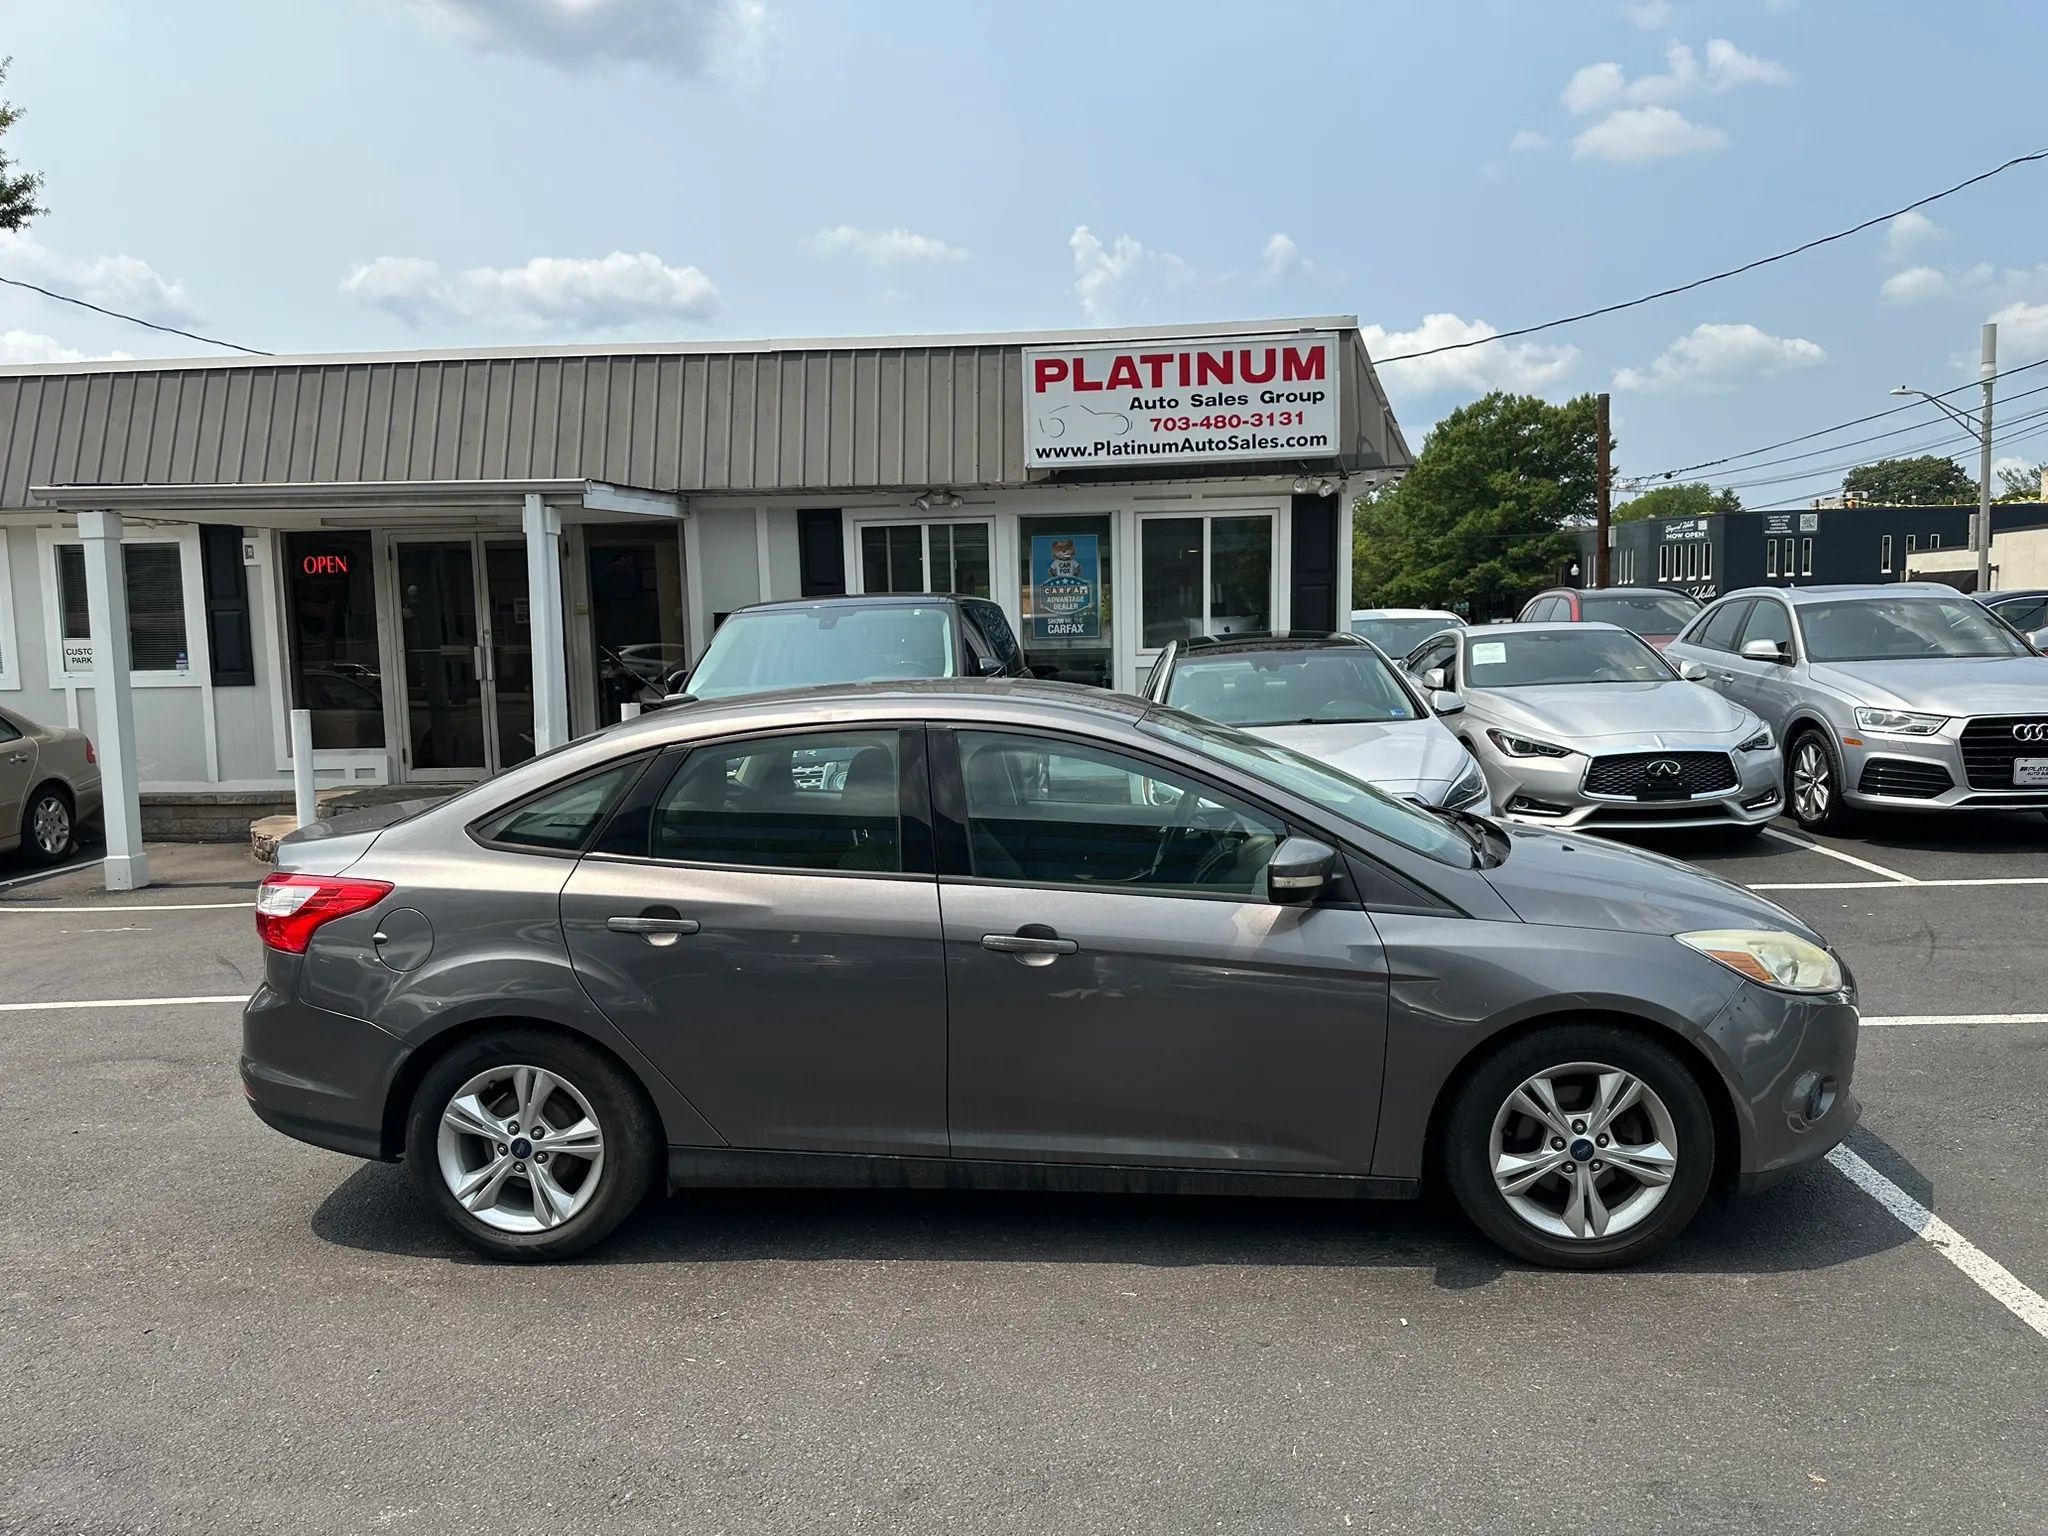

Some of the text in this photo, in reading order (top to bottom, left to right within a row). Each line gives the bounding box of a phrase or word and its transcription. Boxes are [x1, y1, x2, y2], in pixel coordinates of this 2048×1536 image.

[1035, 346, 1326, 393] PLATINUM
[1129, 389, 1326, 411] Auto Sales Group
[1150, 411, 1305, 432] 703-480-3131
[1035, 432, 1328, 459] www.PlatinumAutoSales.com
[1666, 532, 1683, 540] NOW
[1684, 531, 1705, 539] OPEN
[303, 556, 347, 575] OPEN
[1044, 586, 1088, 595] CARFAX
[1047, 624, 1084, 634] CARFAX
